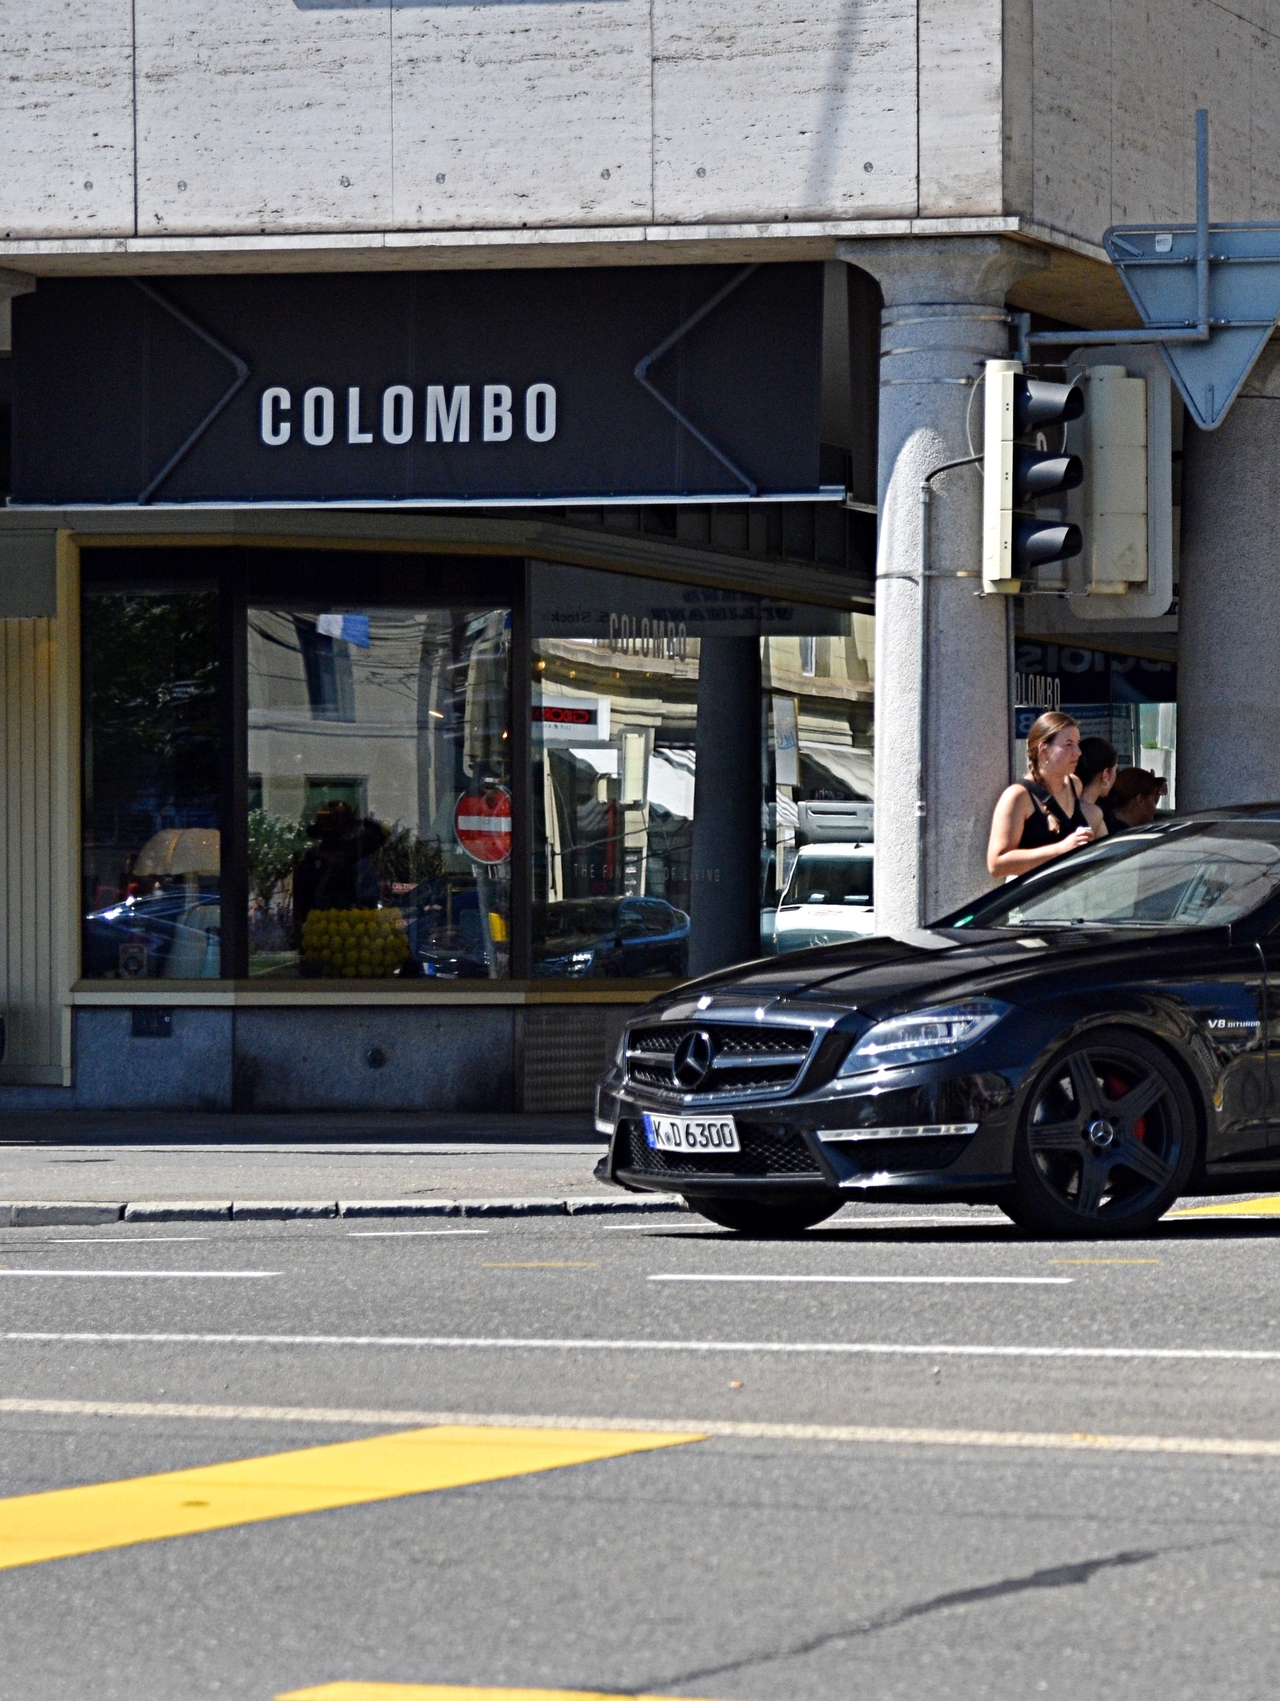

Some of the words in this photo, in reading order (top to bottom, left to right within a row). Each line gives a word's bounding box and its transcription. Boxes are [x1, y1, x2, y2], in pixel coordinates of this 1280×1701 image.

[262, 383, 556, 446] COLOMBO
[609, 613, 687, 662] COLOMBO
[574, 863, 595, 878] THE
[684, 868, 720, 882] LVING
[1208, 1019, 1226, 1028] V8
[1227, 1020, 1261, 1028] BITURBO
[685, 1122, 735, 1148] 6300
